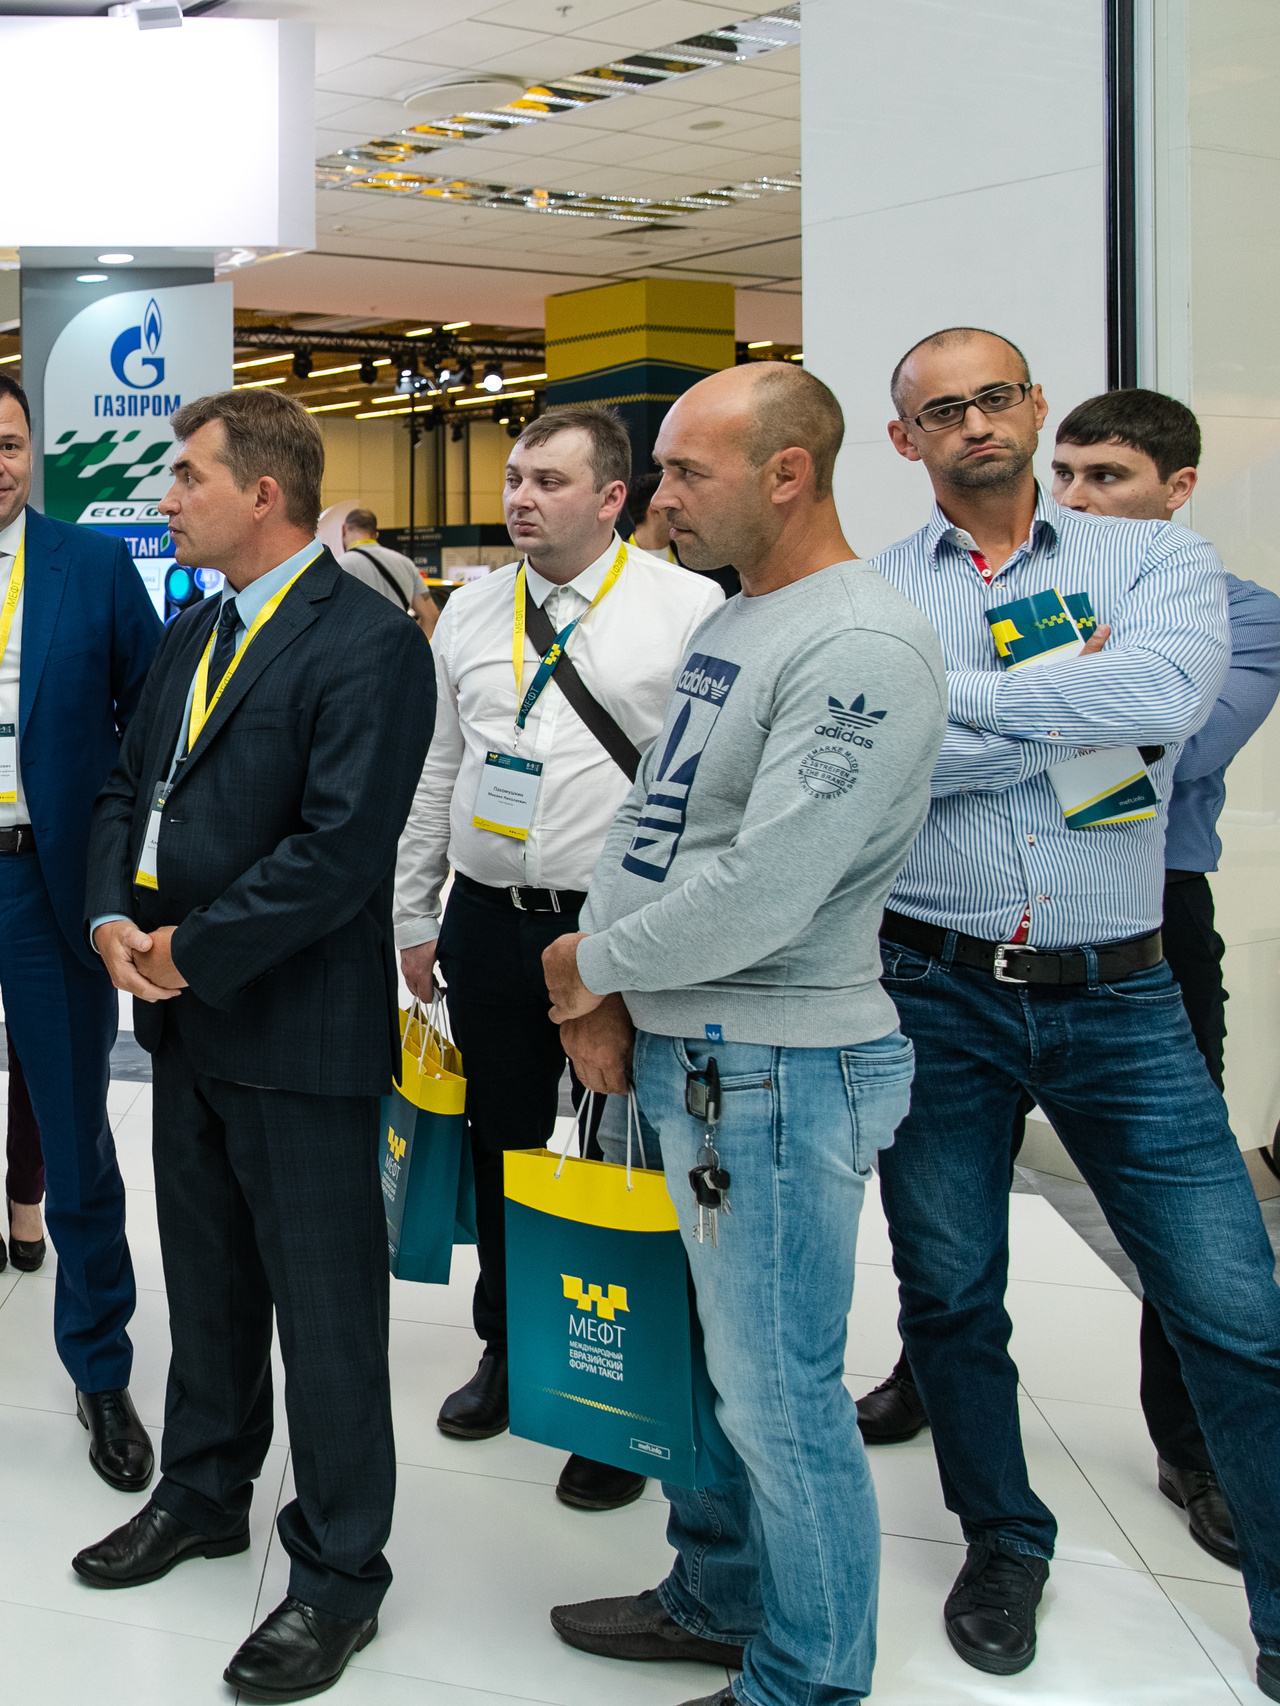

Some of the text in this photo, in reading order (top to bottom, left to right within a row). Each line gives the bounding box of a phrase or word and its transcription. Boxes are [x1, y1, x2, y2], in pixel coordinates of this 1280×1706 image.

[94, 394, 181, 417] ГАЗПРОМ
[90, 507, 135, 518] ECO
[610, 554, 626, 578] МЕФТ
[7, 580, 21, 608] МЕФТ
[515, 609, 524, 635] МЕФТ
[522, 685, 540, 714] МЕФТ
[814, 724, 874, 749] adidas
[820, 773, 846, 787] BRAND
[569, 1314, 626, 1348] МЕФТ
[569, 1340, 623, 1361] МЕЖДУНАРОДНЫЙ
[569, 1348, 624, 1372] ЕВРАЗИЙСКИЙ
[569, 1358, 624, 1382] ФОРУМ ТАКСИ
